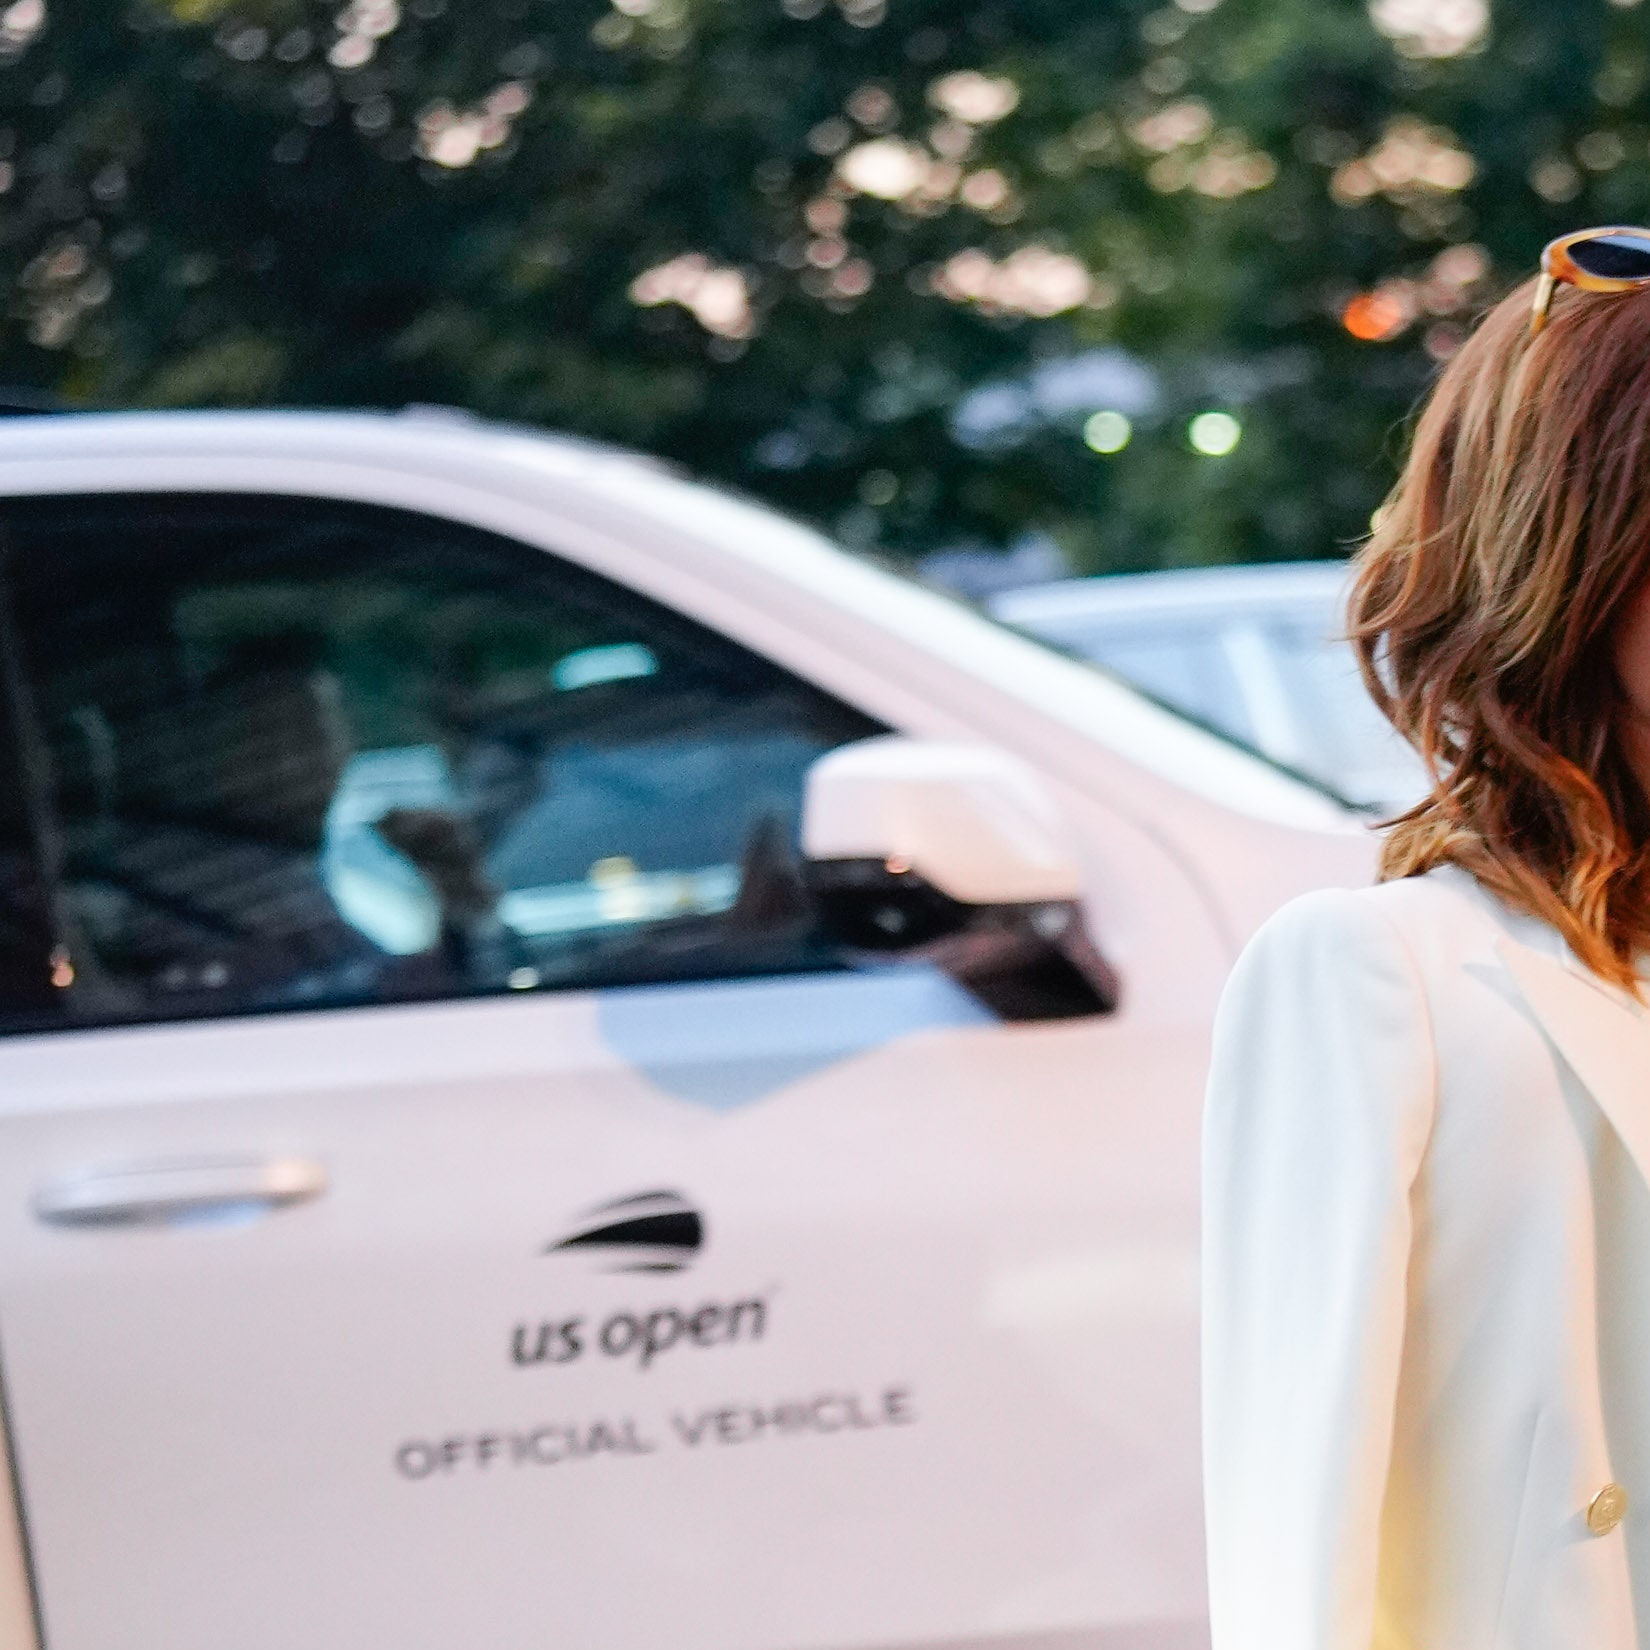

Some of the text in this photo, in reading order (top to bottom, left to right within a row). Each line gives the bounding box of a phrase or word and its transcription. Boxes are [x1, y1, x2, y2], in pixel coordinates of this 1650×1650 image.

[509, 1296, 768, 1371] us open
[395, 1387, 913, 1480] OFFICIAL VEHICLE
